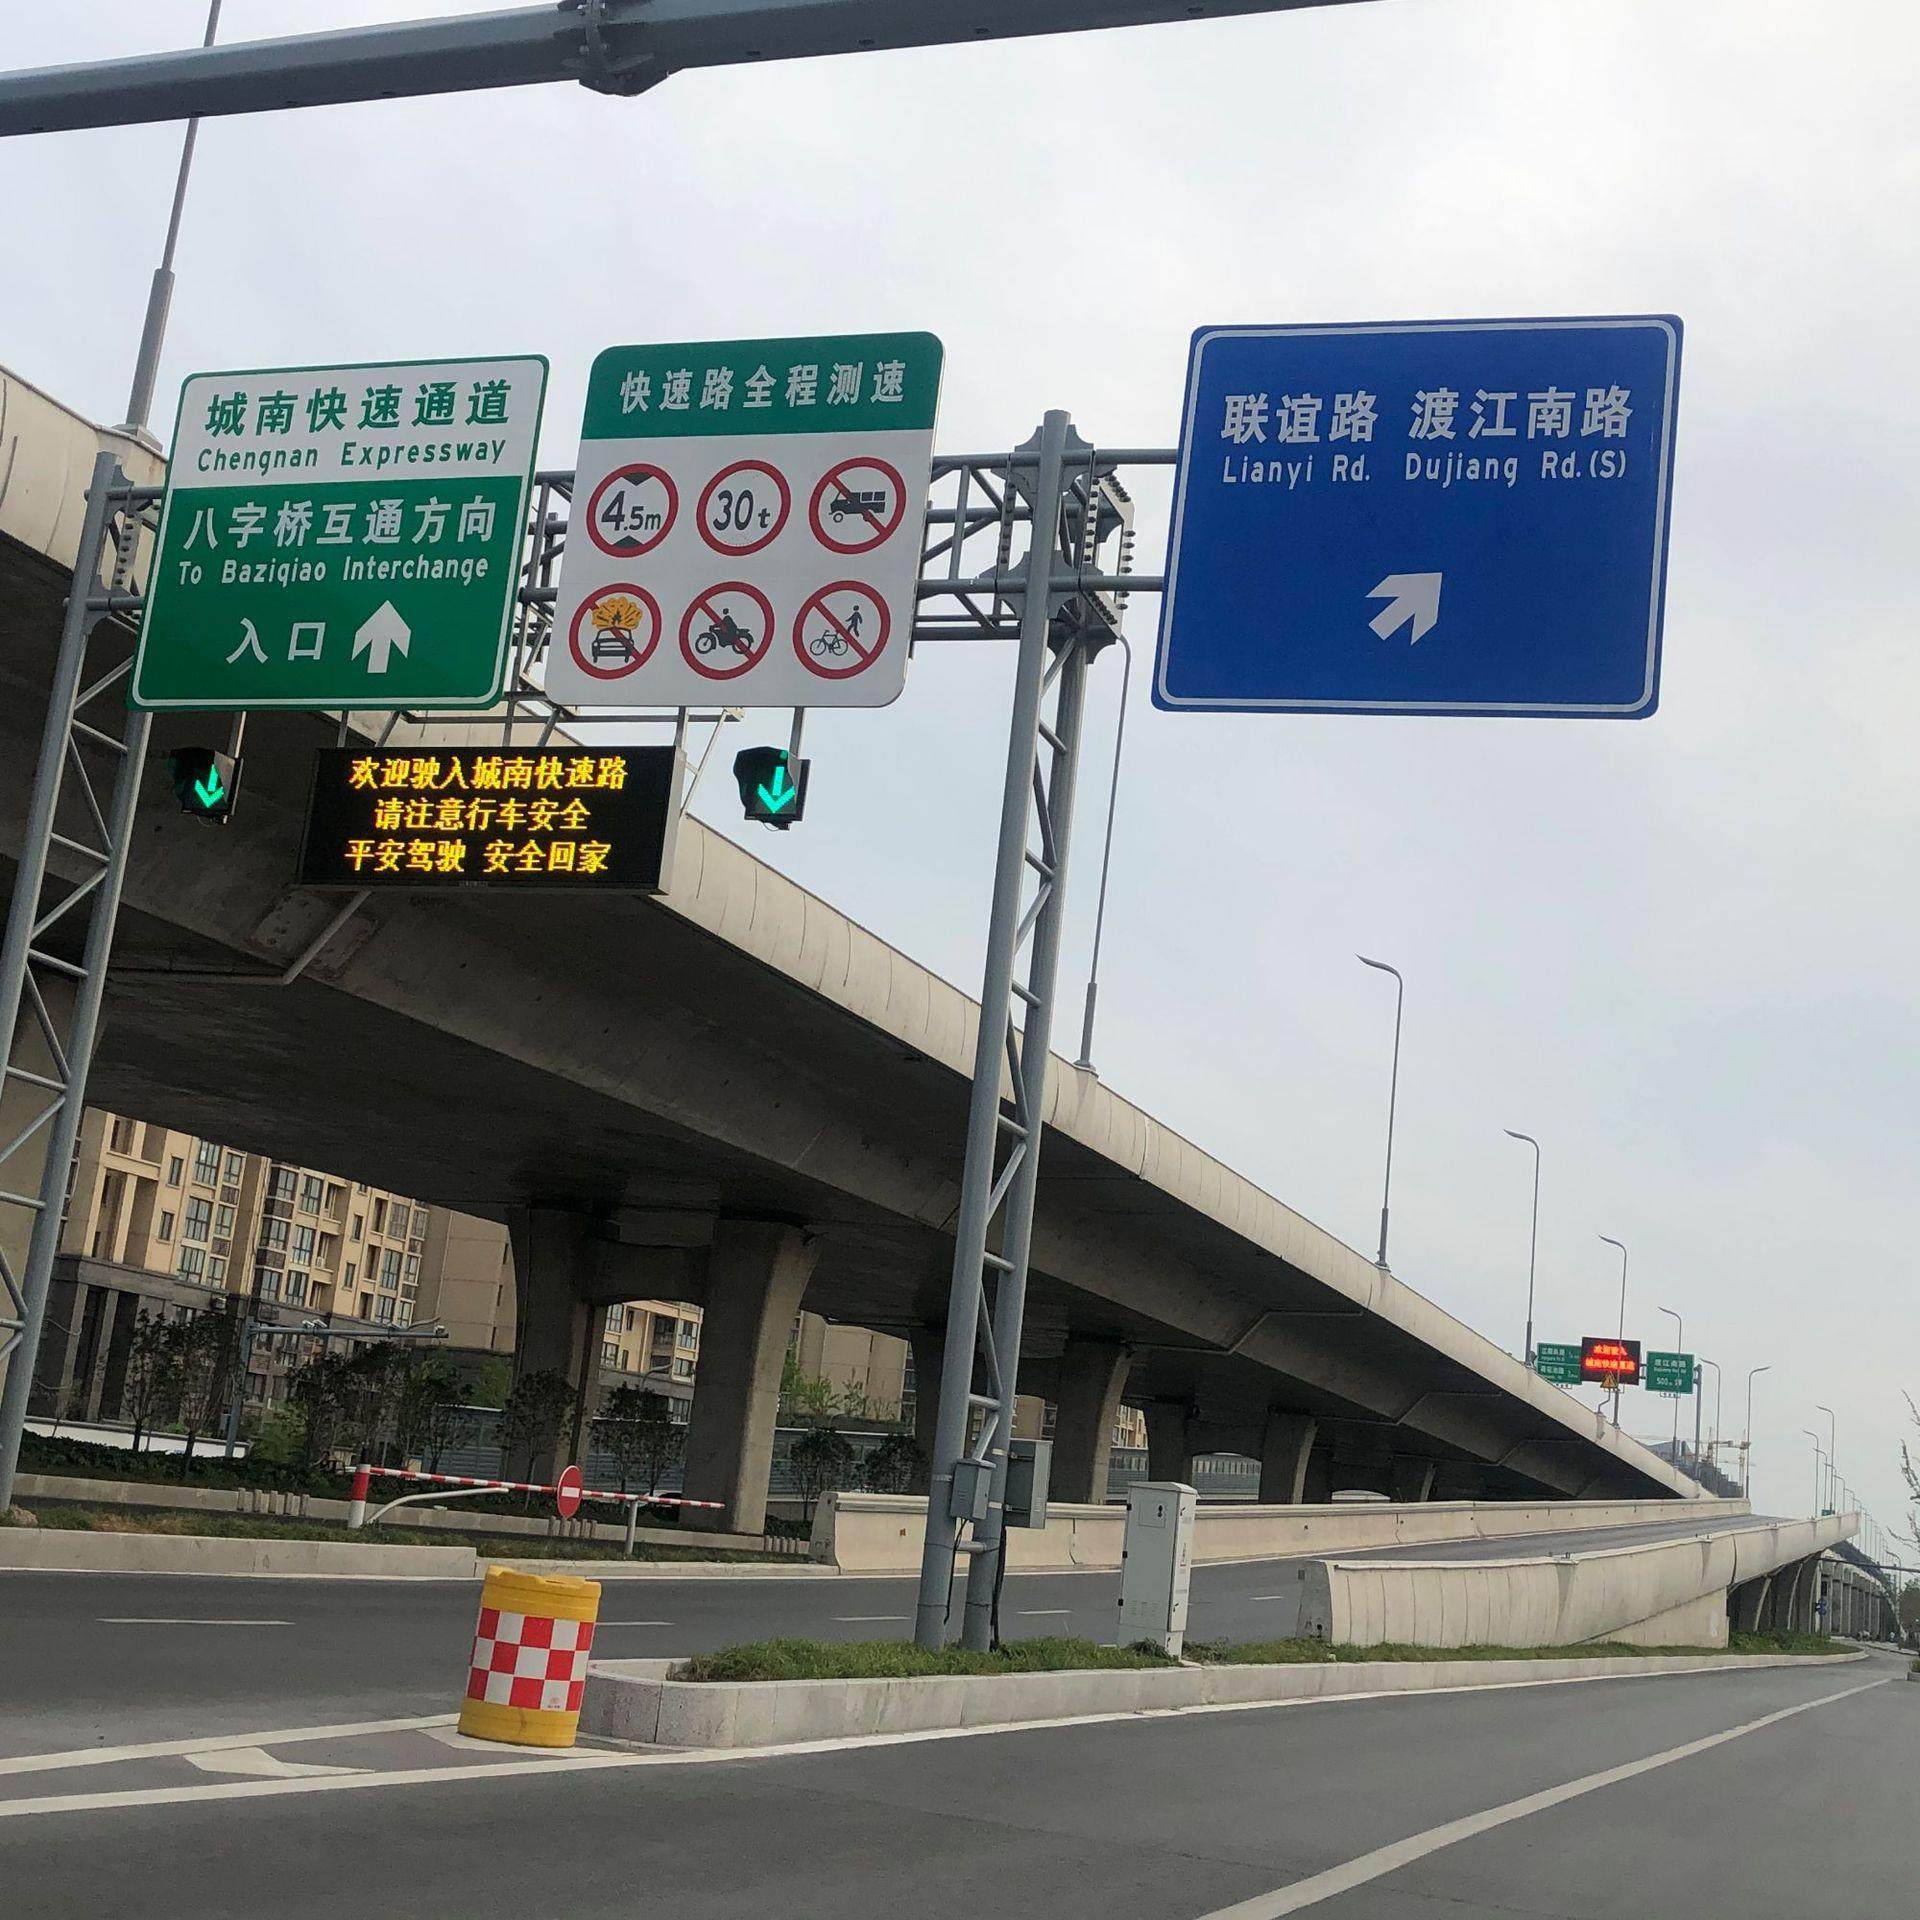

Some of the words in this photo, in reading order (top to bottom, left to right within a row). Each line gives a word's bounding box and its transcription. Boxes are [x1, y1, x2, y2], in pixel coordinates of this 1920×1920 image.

[620, 359, 906, 415] 快速路全程测速
[204, 379, 512, 438] 城南快速通道
[1221, 389, 1379, 444] 联谊路
[1408, 385, 1635, 441] 渡江南路
[198, 443, 319, 476] Chengnan
[341, 439, 506, 471] Expressway
[1223, 453, 1314, 490] Lianyi
[1332, 453, 1371, 483] Rd.
[1406, 451, 1519, 488] Dujiang
[183, 494, 498, 552] 八字桥互通方向
[601, 490, 662, 532] 4.5m
[179, 560, 203, 587] To
[221, 557, 327, 589] Baziqiao
[342, 554, 489, 586] Interchange
[225, 617, 327, 665] 入口
[349, 756, 628, 790] 欢迎驶入城南快速路
[374, 798, 592, 832] 请注意行车安全
[345, 839, 467, 873] 平安驾驶
[483, 839, 613, 875] 安全回家
